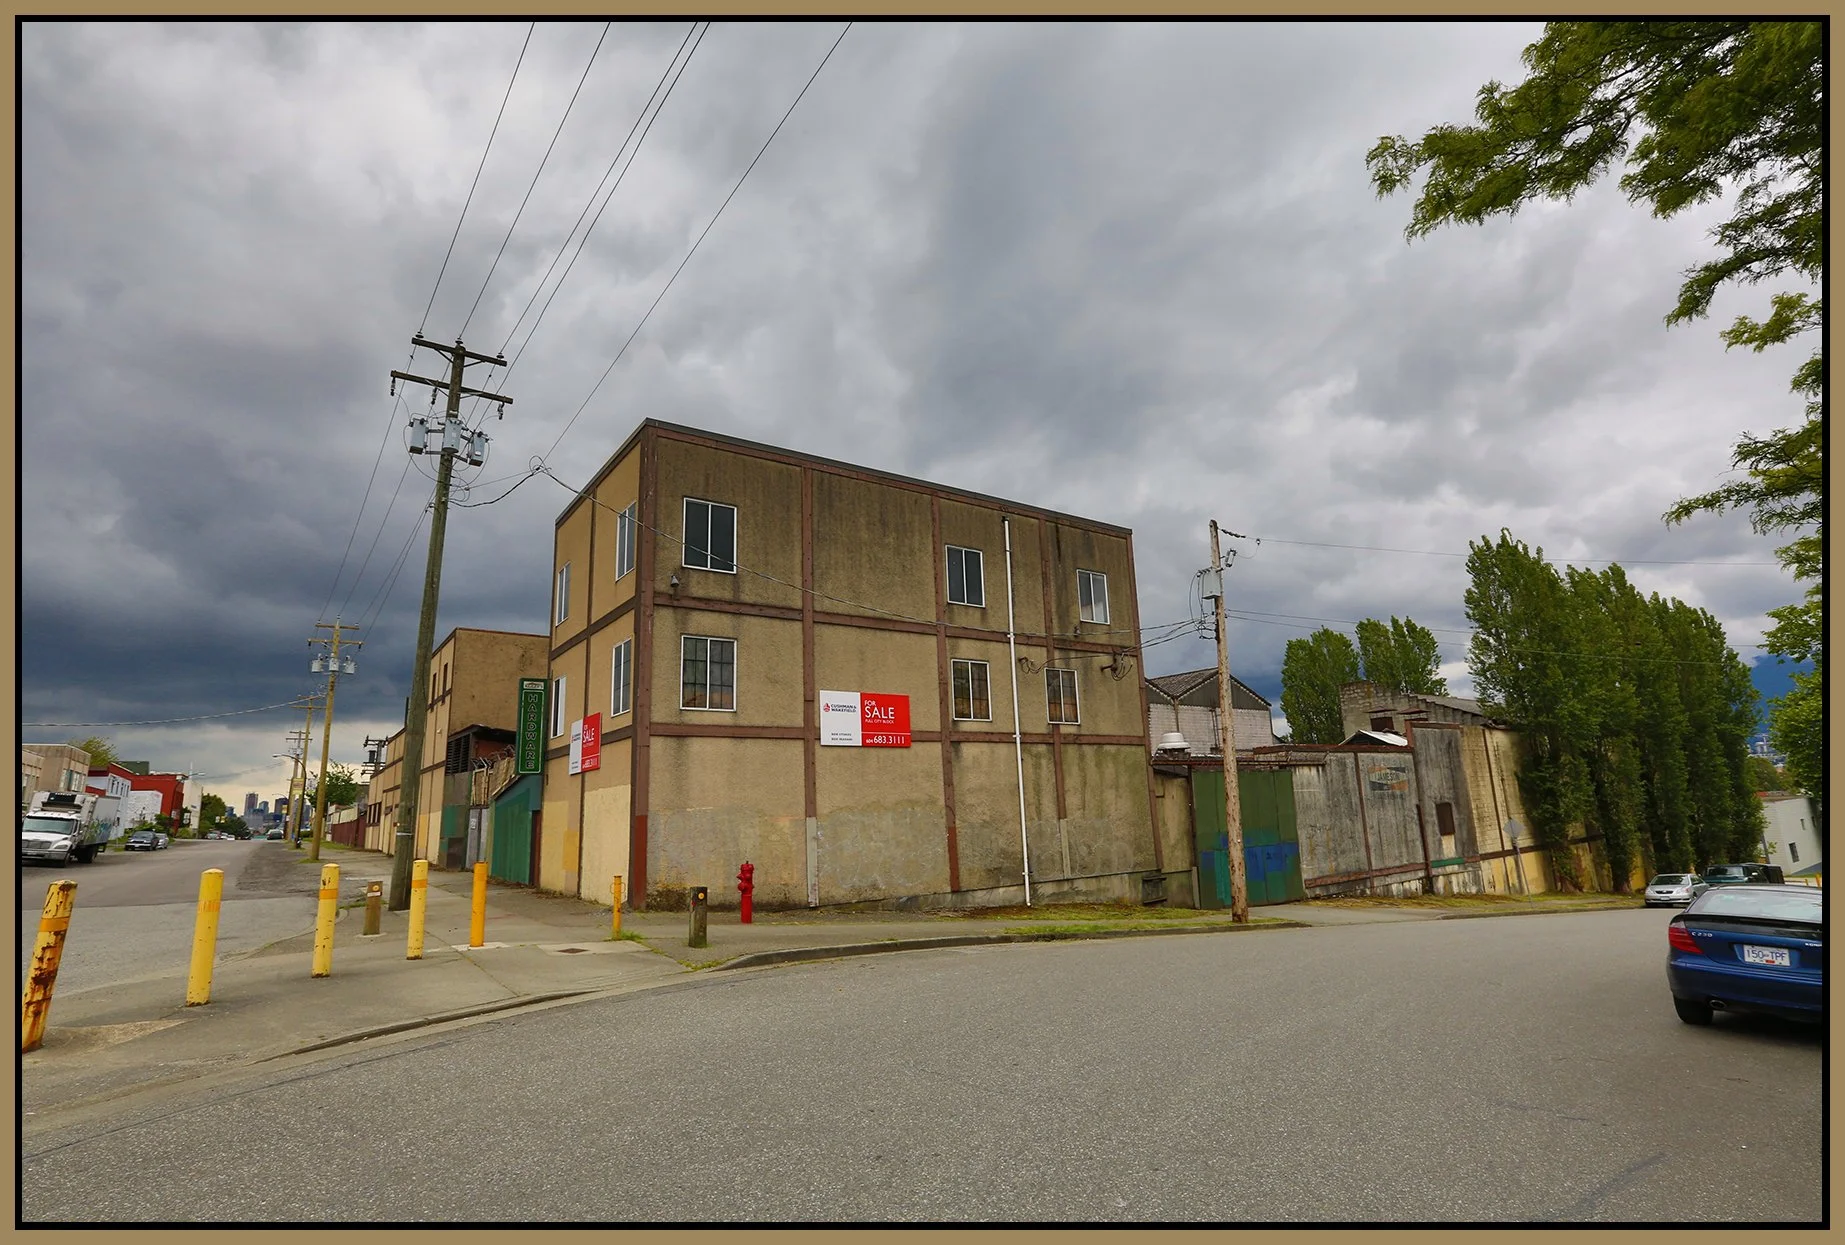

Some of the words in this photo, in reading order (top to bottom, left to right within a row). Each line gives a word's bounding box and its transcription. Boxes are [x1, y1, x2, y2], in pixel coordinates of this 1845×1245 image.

[865, 706, 895, 719] SALE
[526, 694, 538, 769] HARDWARE
[583, 728, 594, 743] SALE
[873, 735, 905, 744] 683.3111
